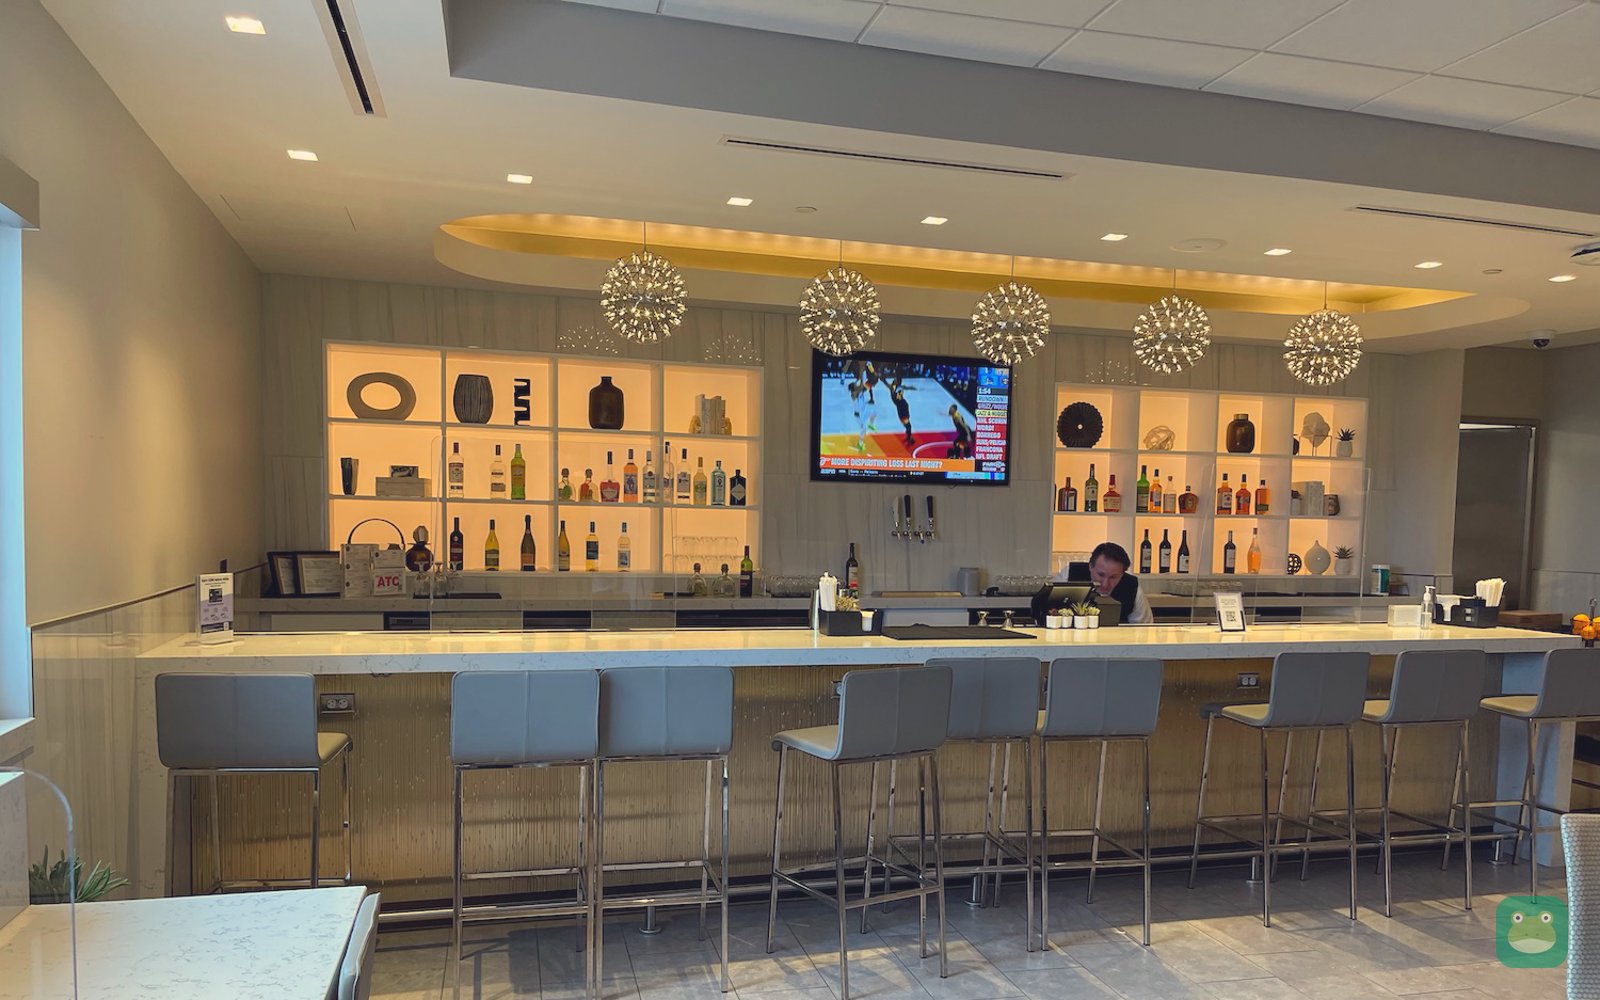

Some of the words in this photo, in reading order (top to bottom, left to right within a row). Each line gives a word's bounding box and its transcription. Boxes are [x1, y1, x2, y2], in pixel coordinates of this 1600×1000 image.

[831, 457, 850, 466] MORE
[888, 459, 904, 468] LOSS
[904, 460, 919, 468] LAST
[919, 460, 943, 469] NIGHT?
[377, 575, 400, 587] ATC
